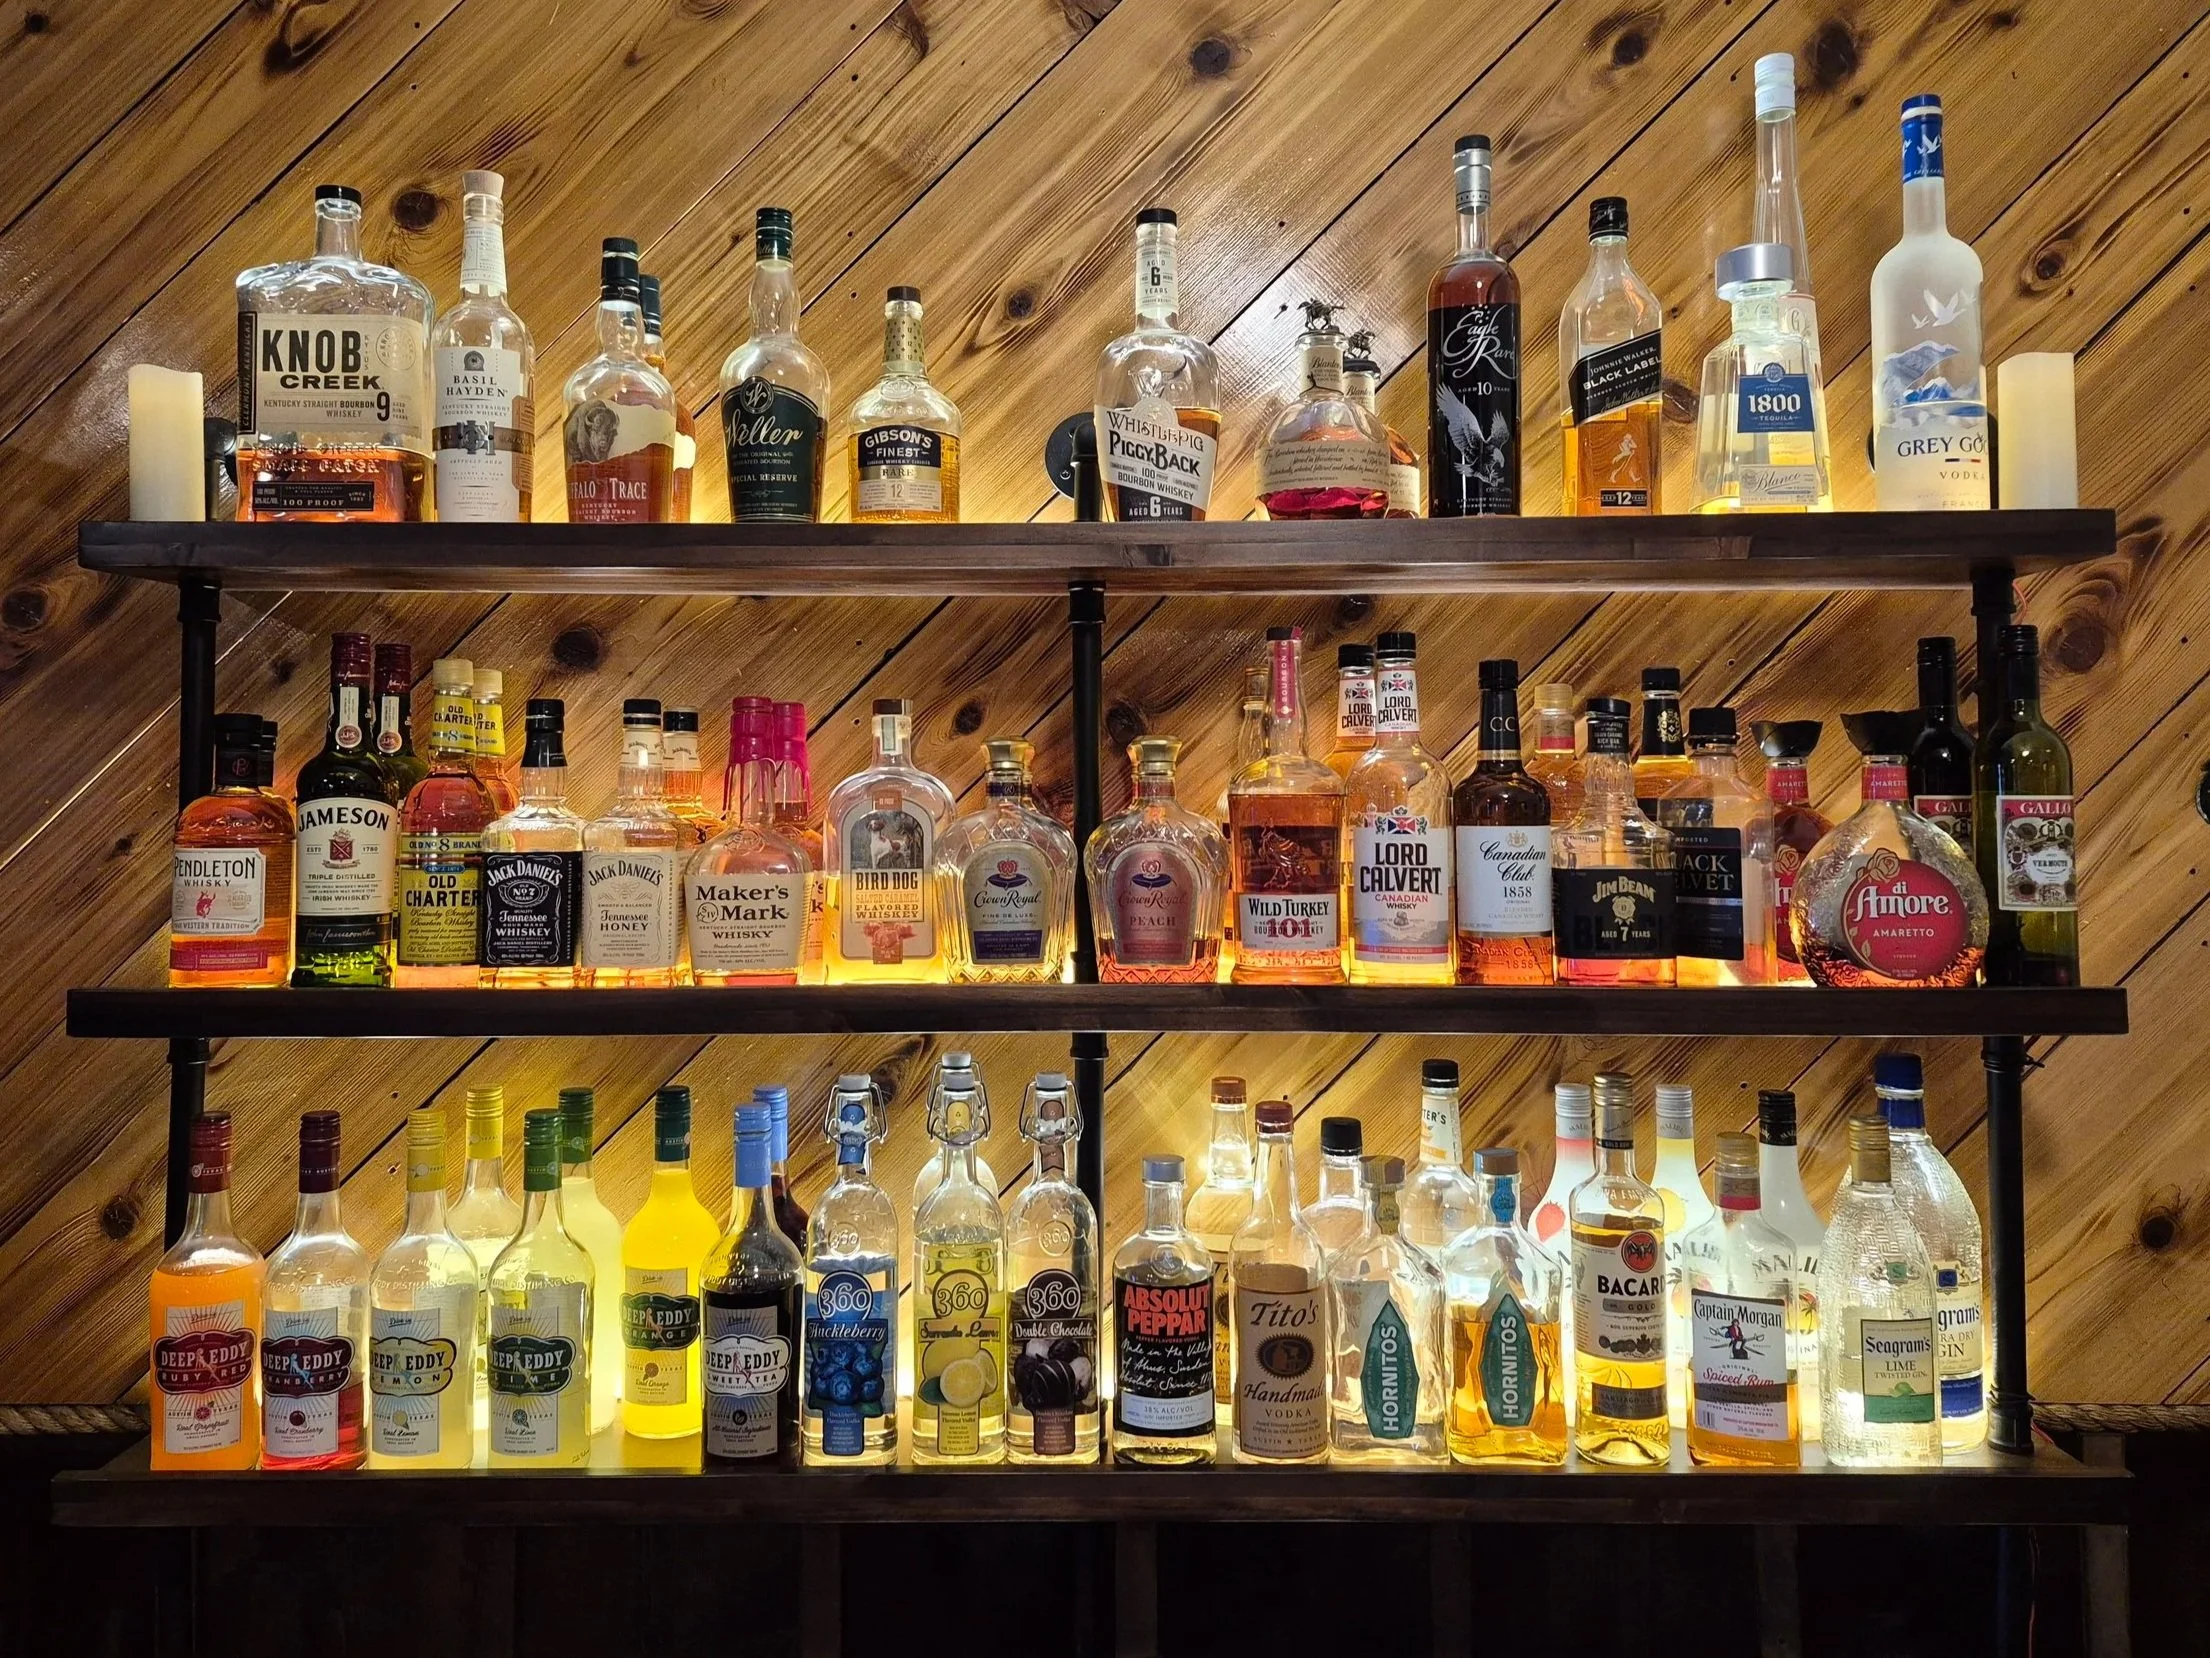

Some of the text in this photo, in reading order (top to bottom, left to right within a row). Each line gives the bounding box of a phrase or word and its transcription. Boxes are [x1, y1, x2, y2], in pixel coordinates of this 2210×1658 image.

[1151, 266, 1161, 286] 6
[1443, 305, 1507, 358] Eagle
[262, 329, 361, 373] KNOB
[1590, 346, 1656, 377] JOHNNIE WALKER
[280, 374, 381, 390] CREEK
[453, 375, 497, 386] BASIL
[1582, 355, 1662, 391] BLACK LABEL
[446, 387, 506, 398] HAYDEN
[1477, 382, 1492, 396] 10
[263, 400, 375, 409] KENTUCKY STRAIGHT BOURBON
[376, 391, 391, 421] 9
[1747, 393, 1801, 413] 1800
[326, 409, 362, 418] WHISKEY
[725, 408, 804, 449] Weller
[865, 429, 933, 448] GIBSON'S
[1897, 436, 1953, 457] GREY
[876, 447, 920, 457] FINEST
[759, 473, 798, 482] RESERVE
[882, 467, 914, 477] RARE
[1141, 467, 1155, 479] 100
[1755, 470, 1800, 492] Blanco
[570, 477, 647, 500] FFALO TRACE
[890, 483, 904, 498] 12
[1117, 471, 1155, 490] BOURBON
[1156, 482, 1194, 501] WHISKEY
[1128, 495, 1184, 518] AGED 6 YEARS
[1616, 491, 1632, 505] 12
[448, 705, 464, 714] OLD
[1348, 703, 1372, 714] LORD
[1385, 696, 1411, 708] LORD
[1378, 708, 1417, 724] CALVERT
[1934, 801, 1971, 813] GAL
[2020, 801, 2071, 814] GALLO
[299, 807, 390, 832] JAMESON
[438, 837, 450, 851] 8
[1479, 840, 1546, 861] Canadian
[1375, 842, 1427, 866] LORD
[1674, 853, 1728, 872] LACK
[174, 856, 256, 879] PENDLETON
[487, 859, 563, 887] JACK DANIEL'S
[588, 860, 664, 887] JACK DANIEL'S
[1497, 860, 1536, 882] Club
[183, 879, 231, 887] WHISKY
[428, 875, 457, 889] OLD
[855, 871, 919, 890] BIRD DOG
[1360, 866, 1441, 895] CALVERT
[1592, 875, 1657, 903] JIM BEAM
[1674, 873, 1735, 891] ELVET
[1892, 881, 1907, 894] di
[406, 889, 482, 907] CHARTER
[528, 887, 535, 896] 7
[695, 884, 789, 901] Maker's
[974, 890, 1041, 908] Crown Royal
[1118, 890, 1188, 908] Crown Royal
[1374, 893, 1429, 903] CANADIAN
[1503, 886, 1532, 898] 1858
[720, 904, 788, 921] Mark
[855, 903, 919, 911] FLAVORED
[1248, 898, 1329, 917] WILD TURKEY
[1386, 902, 1417, 910] WHISKY
[1852, 885, 1949, 922] Amore
[499, 910, 548, 922] Tennessee
[600, 909, 649, 922] Tennessee
[855, 911, 919, 919] WHISKEY
[1129, 916, 1176, 926] PEACH
[211, 922, 250, 930] TRADITION
[495, 927, 551, 937] WHISKEY
[600, 922, 649, 931] HONEY
[712, 930, 773, 939] WHISKY
[1267, 918, 1312, 938] 101
[1601, 926, 1651, 942] AGED 7 YEARS
[1873, 928, 1935, 937] AMARETTO
[1422, 1108, 1447, 1126] TER'S
[1597, 1274, 1667, 1298] BACARD
[820, 1281, 870, 1316] 360
[936, 1281, 986, 1316] 360
[1029, 1281, 1080, 1316] 360
[1124, 1284, 1211, 1313] ABSOLUT
[1628, 1303, 1656, 1311] GOLD
[656, 1307, 693, 1325] EDDY
[1128, 1308, 1206, 1336] PEPPAR
[1250, 1299, 1319, 1328] Tito's
[1694, 1299, 1782, 1329] Captain Morgan
[1938, 1303, 1980, 1332] gram's
[624, 1329, 687, 1340] ORANGE
[807, 1322, 886, 1341] Huckleberry
[1015, 1321, 1093, 1337] Double Chocolate
[1958, 1330, 1975, 1341] DRY
[161, 1341, 248, 1368] DEEP EDDY
[1166, 1343, 1182, 1358] the
[1865, 1335, 1931, 1358] Seagram's
[1940, 1343, 1965, 1358] GIN
[263, 1349, 343, 1371] DEEP EDDY
[405, 1350, 445, 1371] EDDY
[492, 1349, 564, 1369] EEP EDDY
[705, 1350, 781, 1370] DEEP EDDY
[1500, 1314, 1519, 1419] HORNITOS
[1885, 1360, 1917, 1371] LIME
[162, 1363, 247, 1382] RUBY RED
[265, 1371, 344, 1385] RANBERRY
[371, 1373, 441, 1385] LEMON
[707, 1373, 777, 1384] SWEET TEA
[1380, 1324, 1399, 1432] HORNITOS
[1703, 1367, 1776, 1388] Spiced Rum
[1243, 1379, 1324, 1404] Handmad
[213, 1403, 238, 1413] TEXAS
[1161, 1405, 1193, 1413] ALC/VOL
[1265, 1407, 1312, 1418] VODKA
